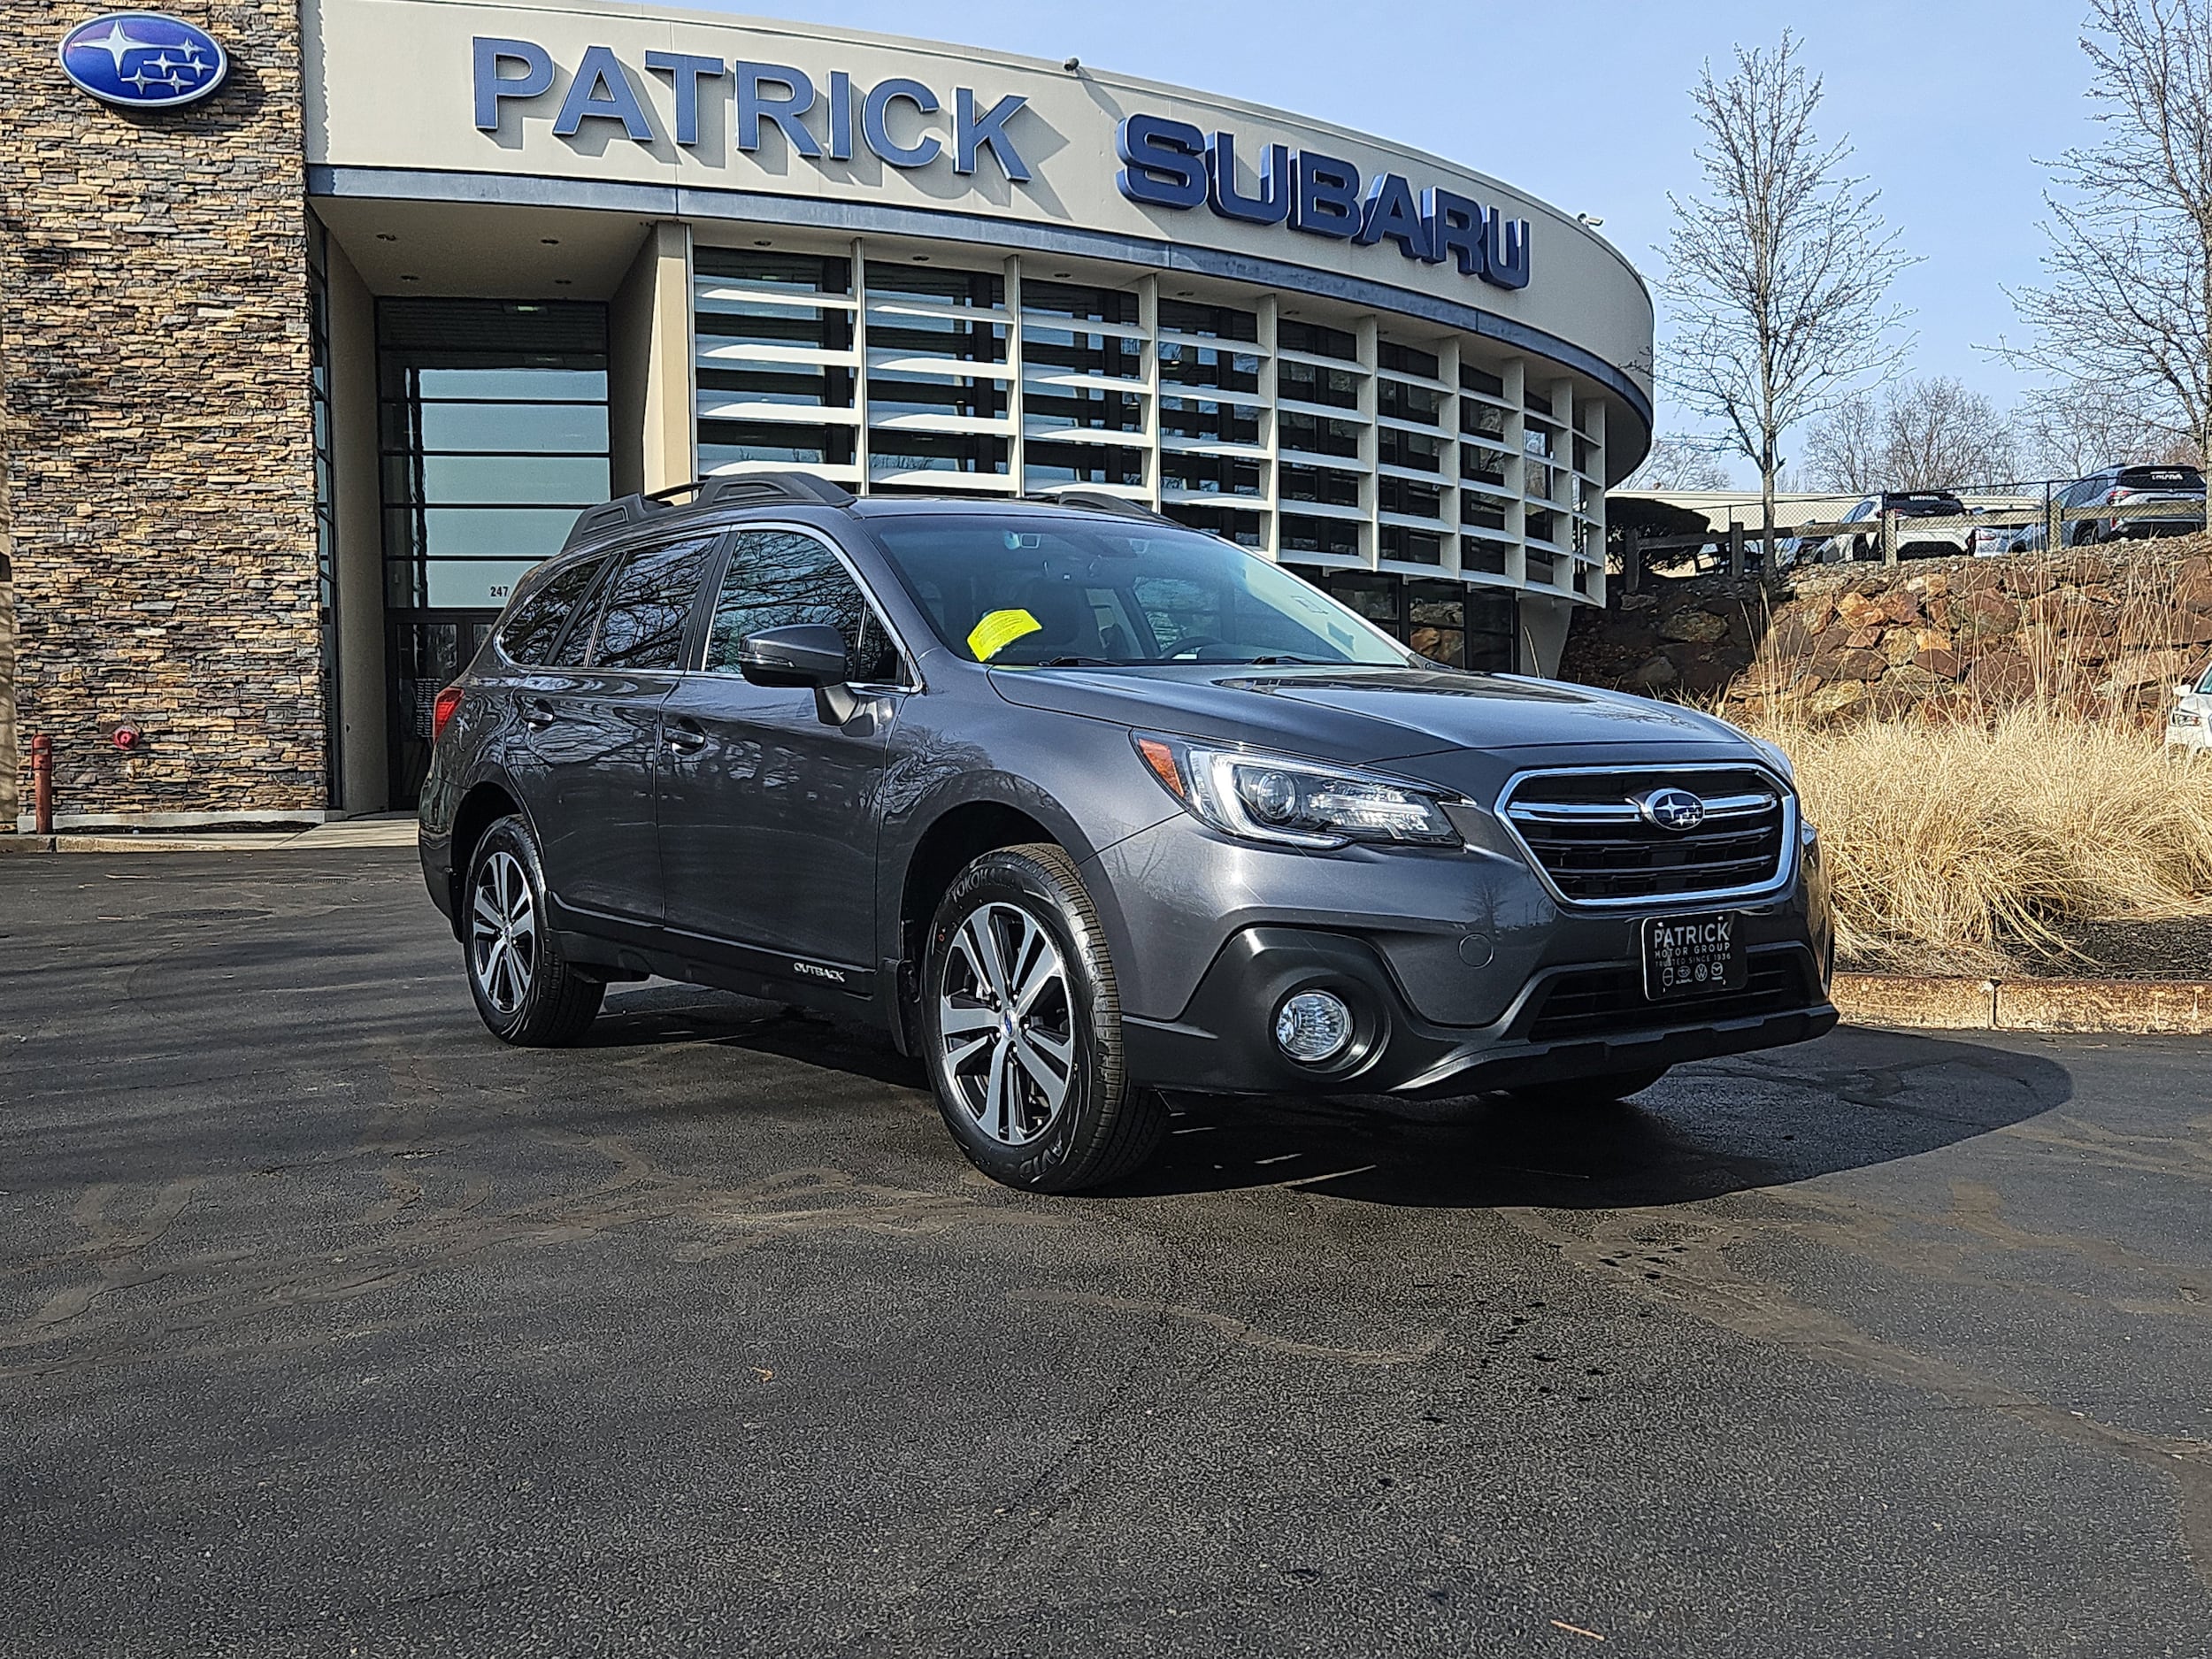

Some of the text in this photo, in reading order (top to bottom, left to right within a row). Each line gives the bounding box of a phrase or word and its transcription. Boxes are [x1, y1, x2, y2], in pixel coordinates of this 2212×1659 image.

[472, 36, 1531, 291] PATRICK SUBARU
[490, 586, 509, 597] 247
[1654, 921, 1730, 949] PATRICK
[1655, 941, 1731, 959] MOTOR GROUP
[1688, 954, 1710, 964] SINCE
[794, 962, 845, 983] OUTBACK
